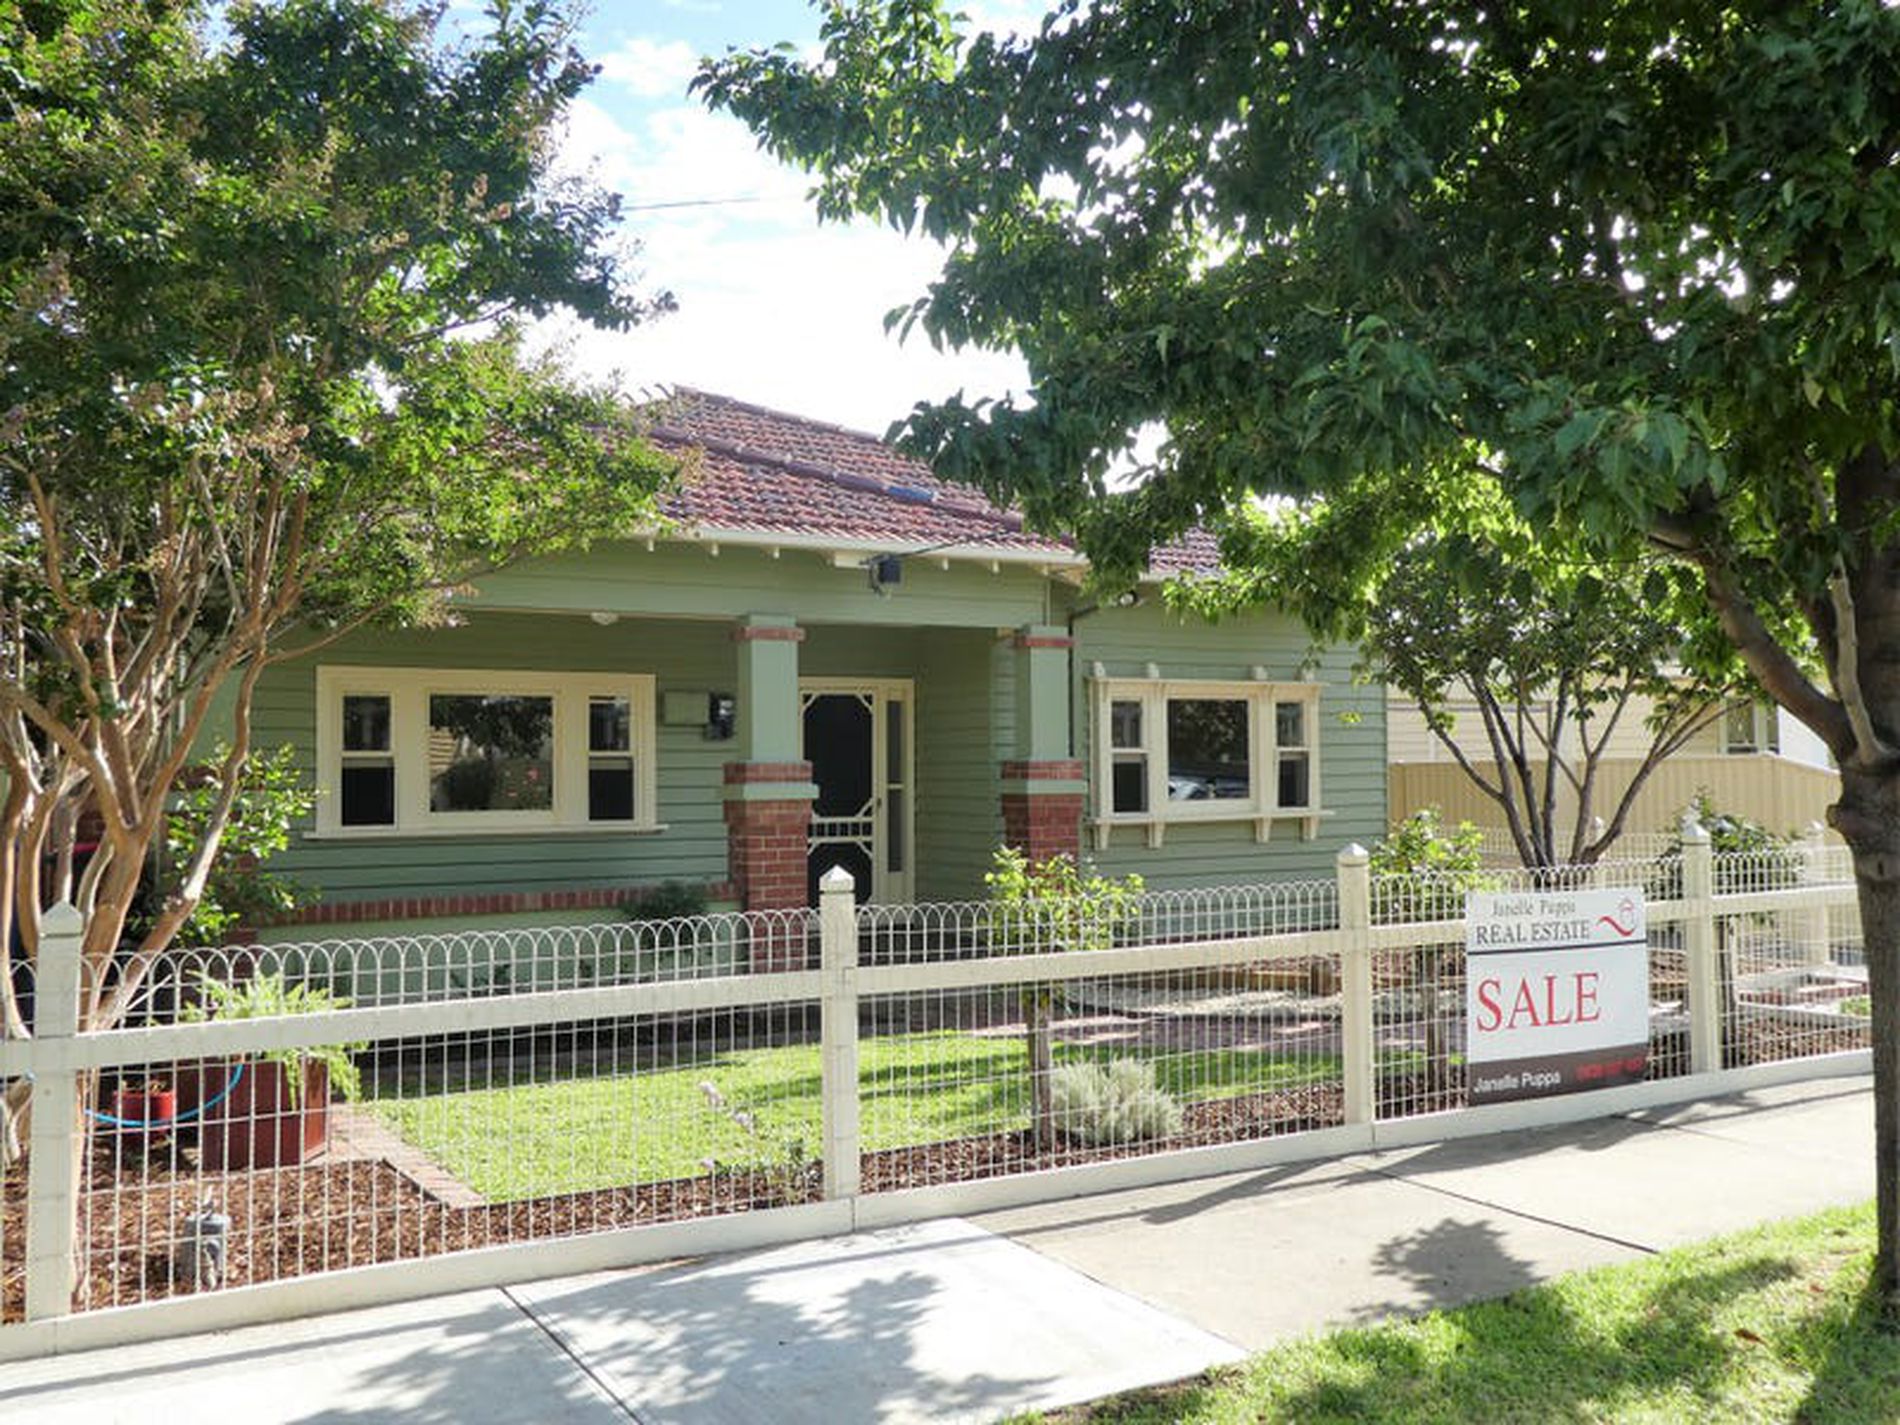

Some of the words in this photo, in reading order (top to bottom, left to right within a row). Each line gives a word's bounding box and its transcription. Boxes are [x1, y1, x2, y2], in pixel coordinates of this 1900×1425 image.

[1492, 900, 1534, 916] Janelle
[1476, 924, 1527, 945] REAL
[1531, 920, 1590, 941] ESTATE
[1476, 972, 1602, 1032] SALE
[1473, 1074, 1518, 1093] Janelle
[1521, 1071, 1561, 1088] Puppa
